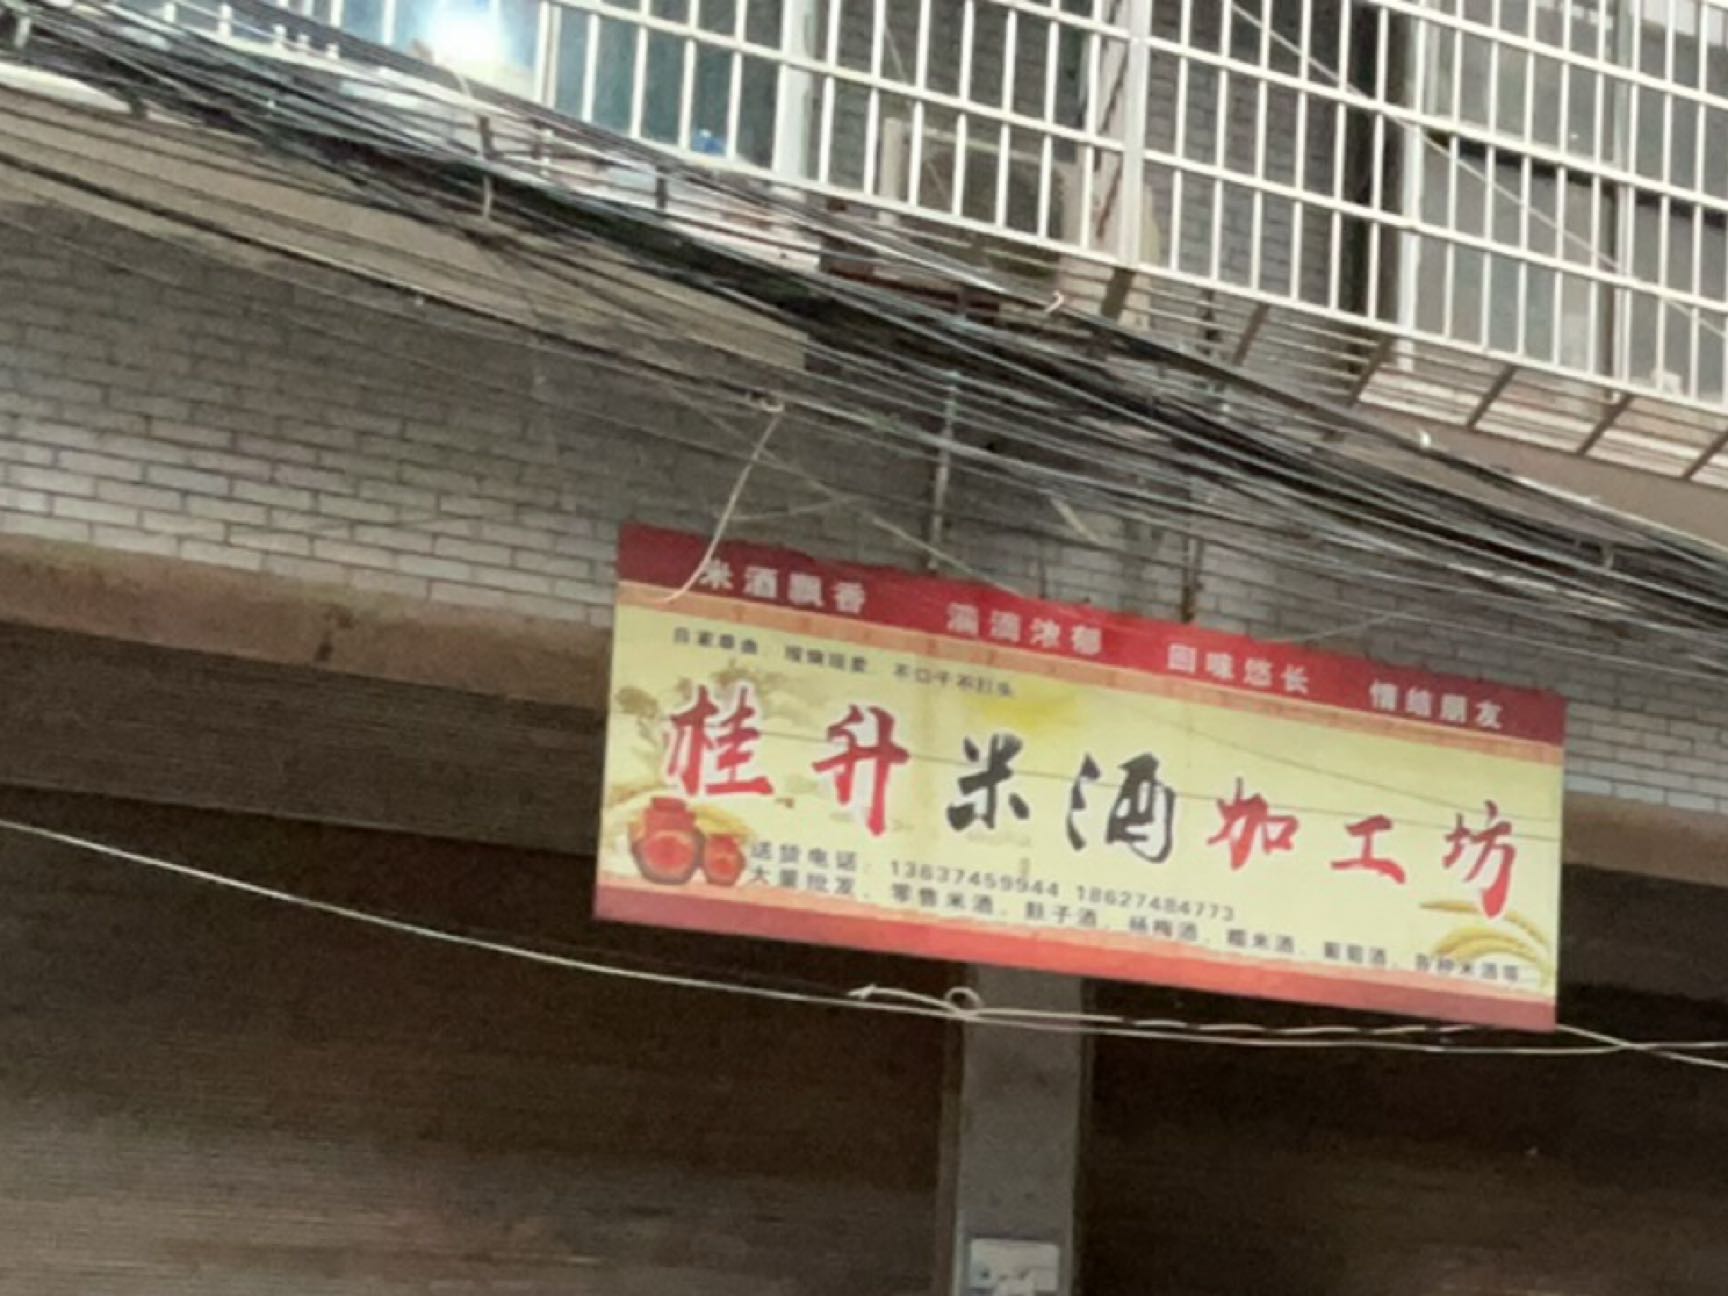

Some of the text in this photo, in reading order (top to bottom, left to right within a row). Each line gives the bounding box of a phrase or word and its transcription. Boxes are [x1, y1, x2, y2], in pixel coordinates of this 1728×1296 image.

[665, 684, 1517, 918] 桂升米酒加工坊
